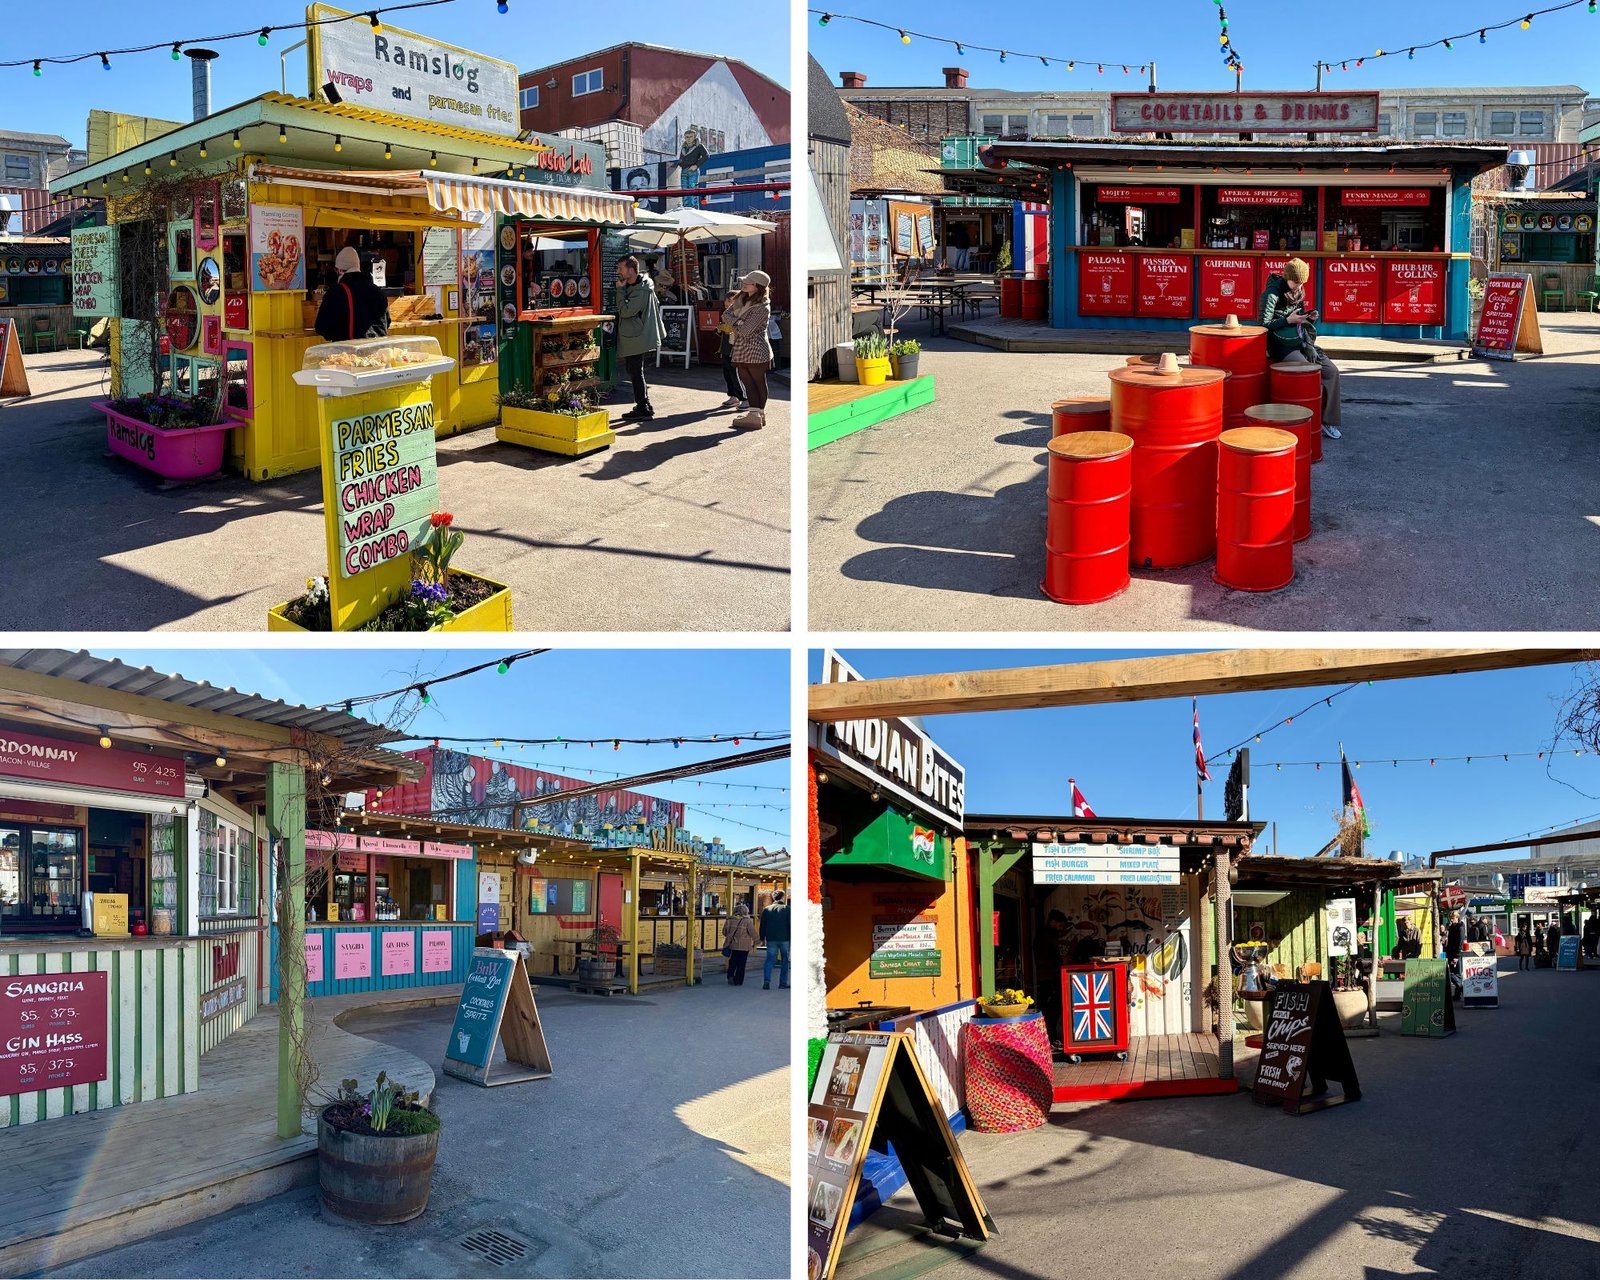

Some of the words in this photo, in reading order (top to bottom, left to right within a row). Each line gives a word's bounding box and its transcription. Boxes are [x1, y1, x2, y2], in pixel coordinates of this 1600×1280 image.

[327, 69, 374, 94] wraps
[392, 85, 412, 101] and
[428, 94, 482, 116] parmesan
[487, 104, 514, 123] fries
[1141, 103, 1244, 121] COCKTAILS
[1254, 103, 1267, 121] &
[1281, 103, 1351, 121] DRINKS
[1088, 256, 1126, 264] PALOMA
[1143, 257, 1177, 266] PASSION
[1205, 260, 1251, 269] CAIPIRINHA
[1328, 262, 1349, 272] GIN
[1350, 263, 1377, 272] HASS
[1147, 265, 1188, 273] MARTINI
[1397, 270, 1438, 279] COLLINS
[1489, 318, 1508, 326] WINE
[337, 402, 434, 450] PARMESAN
[339, 440, 400, 481] FRIES
[341, 464, 422, 513] CHICKEN
[344, 502, 395, 543] WRAP
[345, 529, 409, 575] COMBO
[920, 741, 965, 819] BITES
[1045, 846, 1060, 854] FISH
[1067, 846, 1087, 854] CHIPS
[1120, 847, 1146, 855] SHRIMP
[1045, 860, 1060, 868] FISH
[1062, 860, 1088, 868] BURGER
[1142, 860, 1160, 868] PLATE
[1045, 873, 1063, 882] FRIED
[1064, 873, 1096, 882] CALAMARI
[1120, 874, 1136, 882] FRIED
[481, 907, 497, 917] TOILETS
[474, 960, 503, 976] BnW
[1465, 967, 1494, 979] HYGGE
[4, 981, 84, 998] SANGRIA
[470, 997, 495, 1009] COCKTAILS
[1274, 992, 1310, 1011] FISH
[463, 1009, 487, 1021] SPRITZ
[1268, 1015, 1309, 1042] Chips
[6, 1036, 40, 1052] GIN
[46, 1033, 83, 1048] HASS
[1266, 1042, 1289, 1051] SERVED
[1290, 1045, 1306, 1053] HERE
[1260, 1064, 1282, 1080] FRESH
